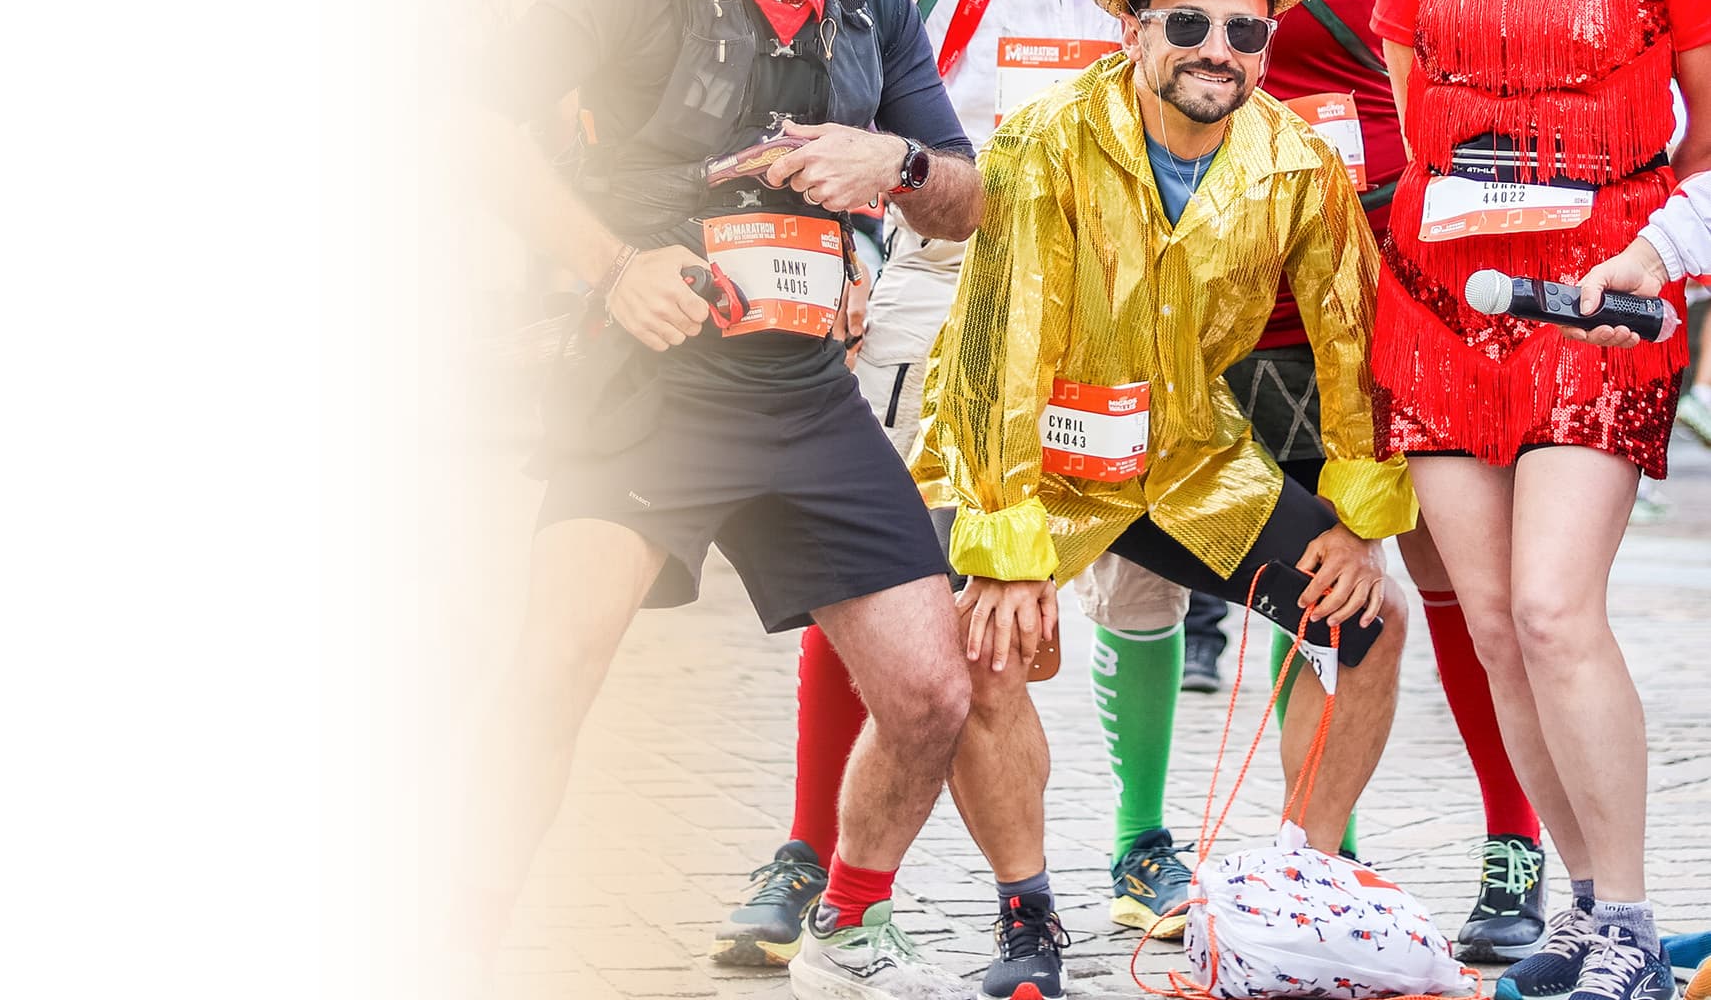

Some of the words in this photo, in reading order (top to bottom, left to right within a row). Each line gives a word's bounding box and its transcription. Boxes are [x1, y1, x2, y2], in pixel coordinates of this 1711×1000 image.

[1483, 191, 1526, 204] 44022
[732, 222, 775, 235] MARATHON
[773, 259, 808, 277] DANNY
[776, 277, 808, 296] 44015
[1049, 414, 1084, 433] CYRIL
[1046, 430, 1086, 449] 44043
